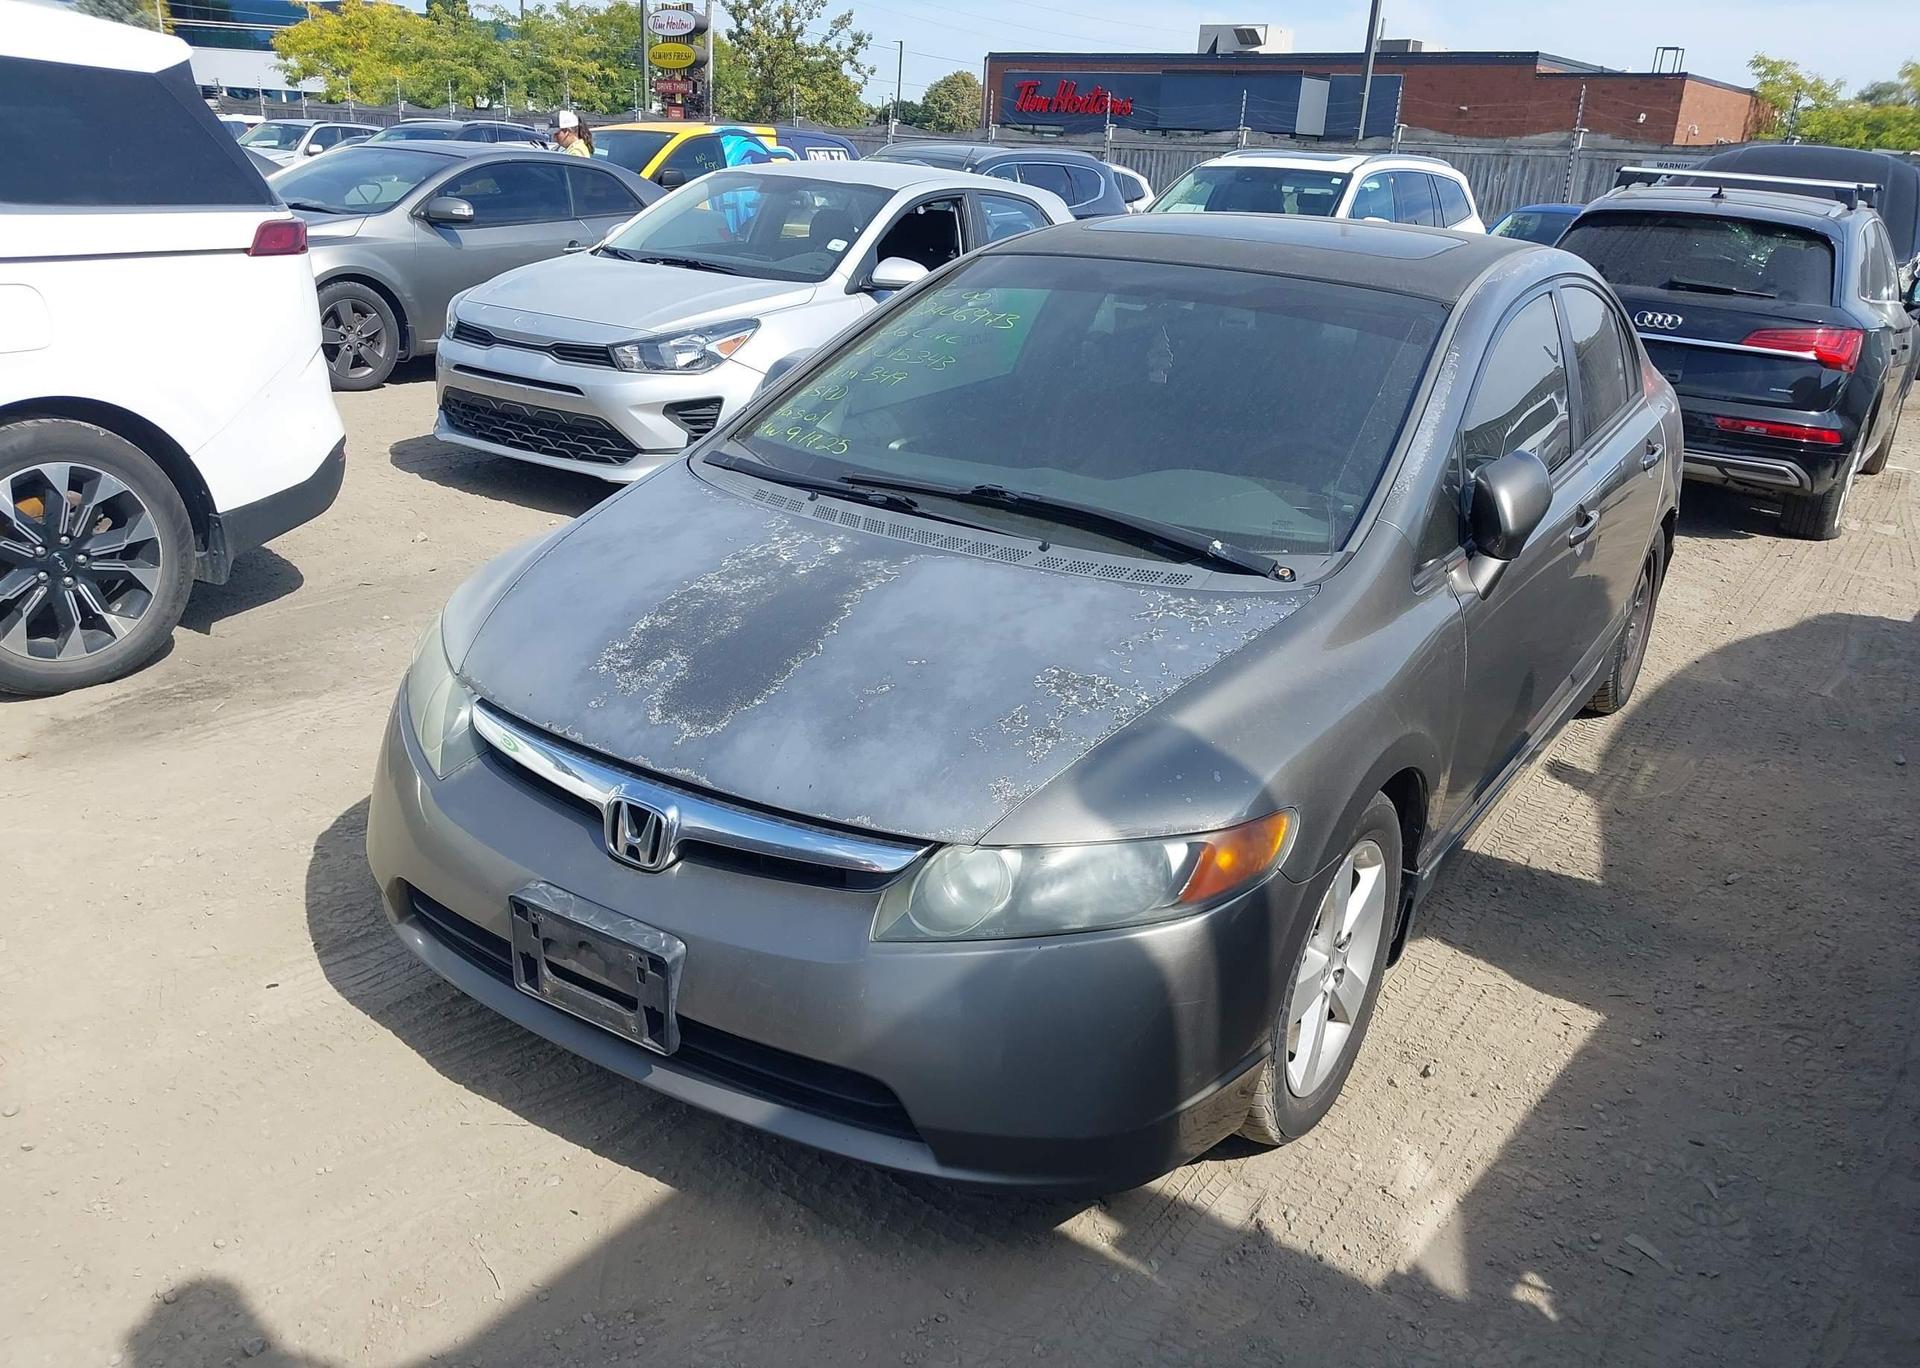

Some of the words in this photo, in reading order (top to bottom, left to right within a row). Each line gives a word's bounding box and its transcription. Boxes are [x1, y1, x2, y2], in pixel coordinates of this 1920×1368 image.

[652, 15, 665, 30] Tim
[666, 15, 692, 30] Hortons
[652, 51, 672, 60] ALWAYS
[673, 51, 692, 61] FRESH
[656, 82, 672, 91] DRIVE
[673, 82, 688, 91] THRU
[1015, 80, 1050, 113] Tim
[1051, 79, 1133, 116] Hortons
[1656, 161, 1691, 170] WARNIN
